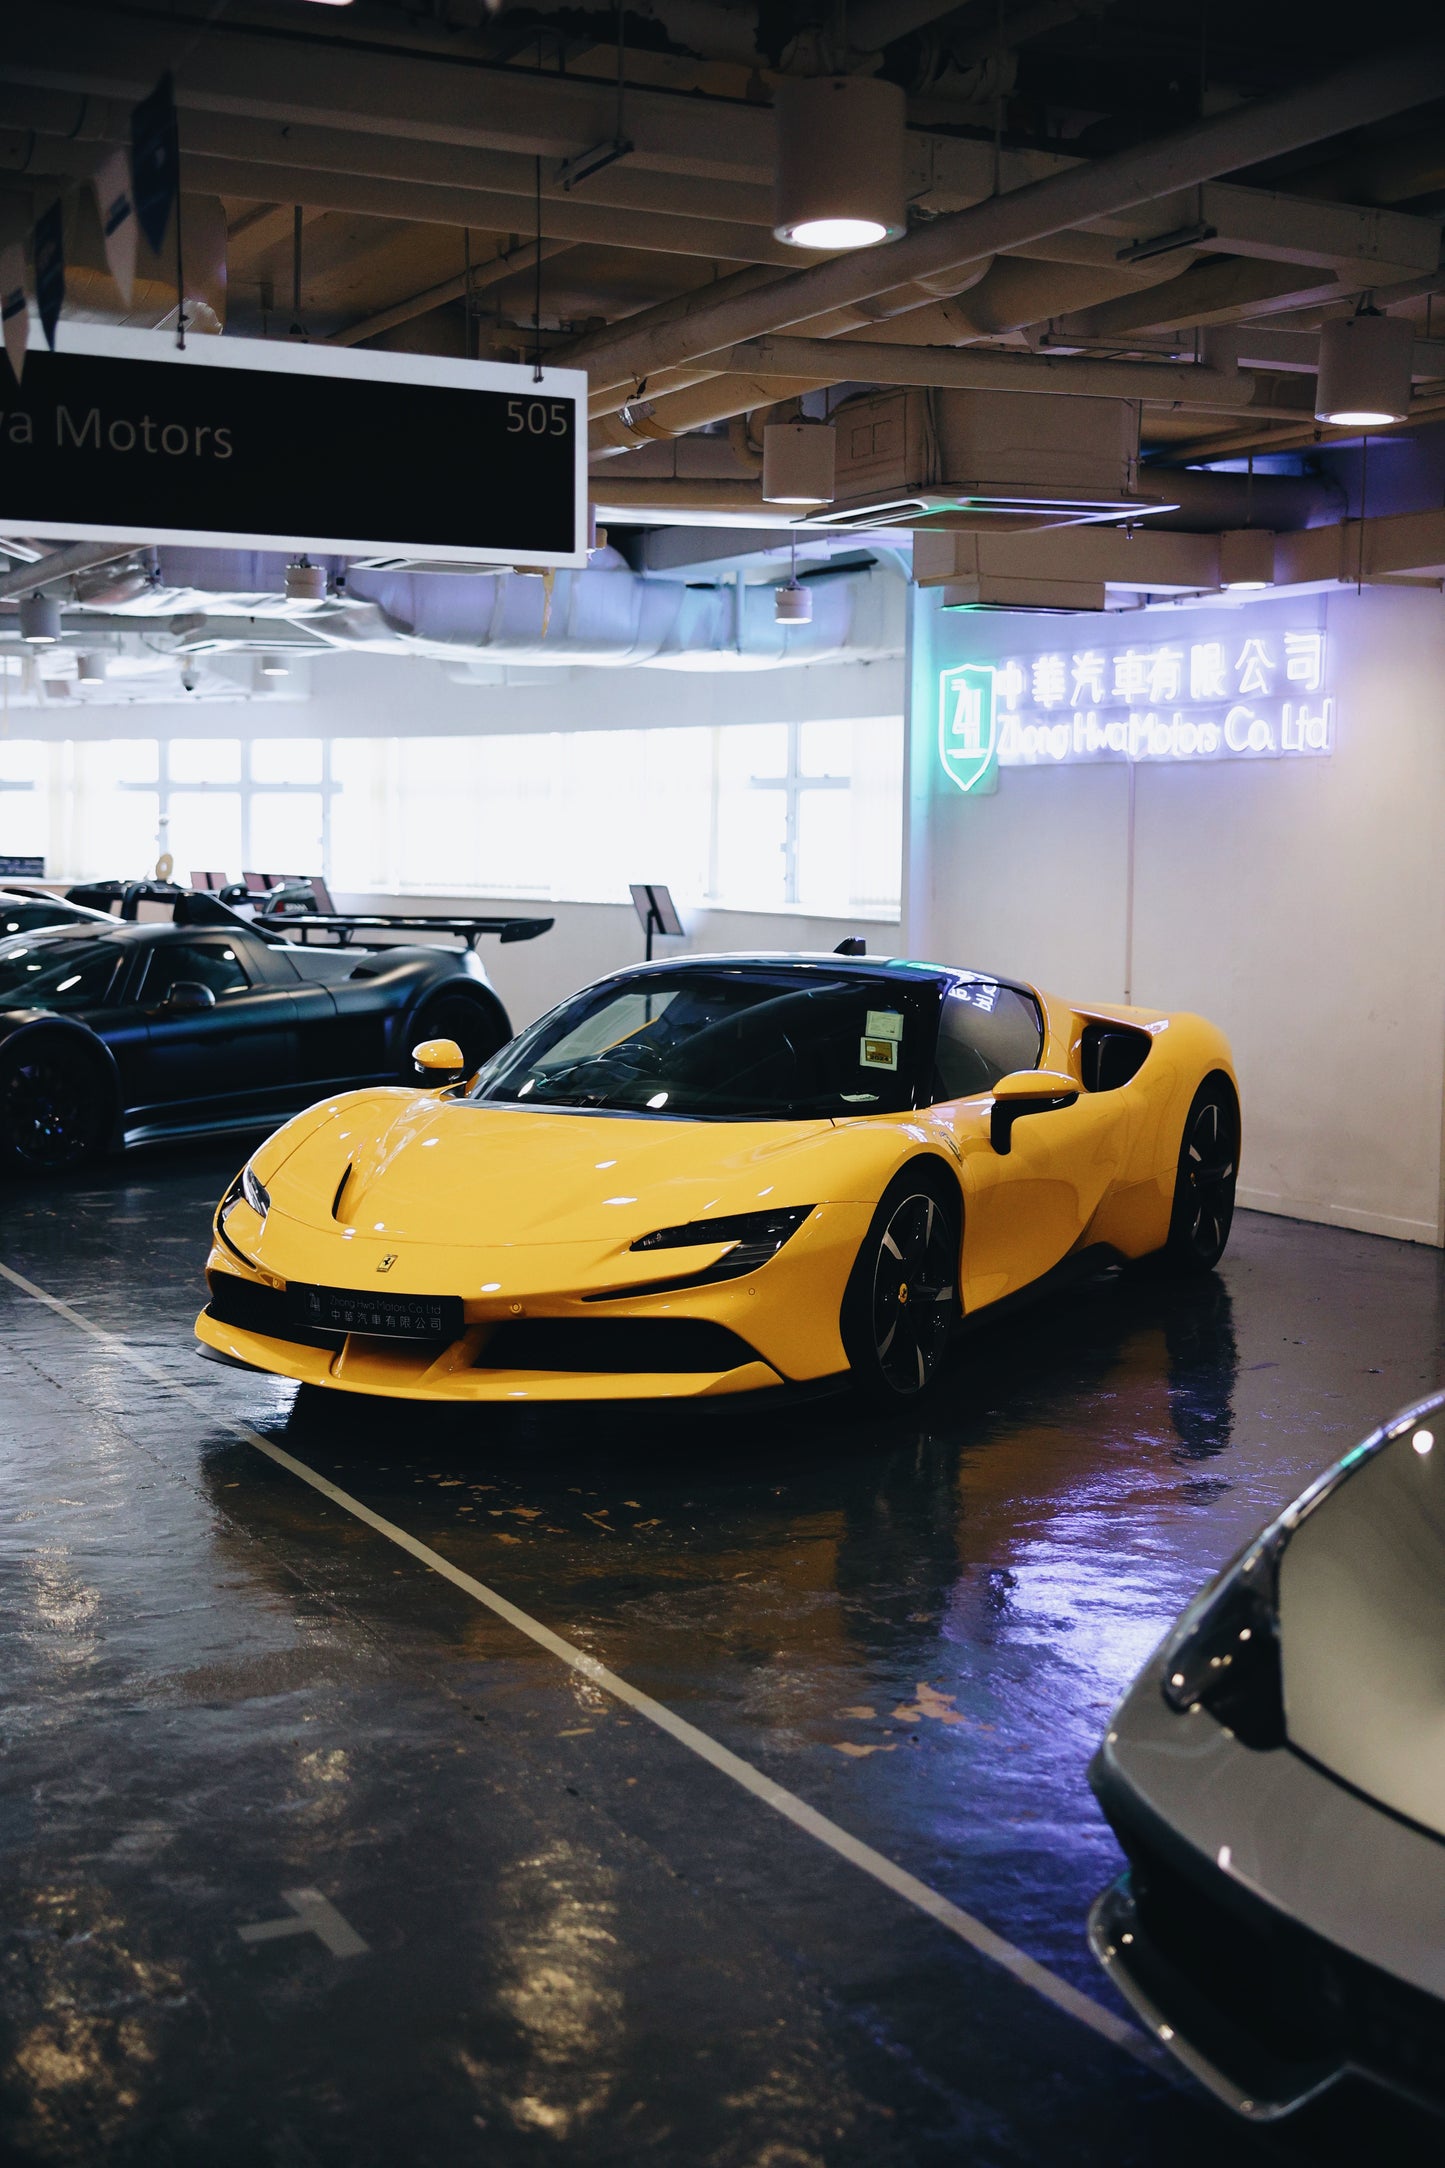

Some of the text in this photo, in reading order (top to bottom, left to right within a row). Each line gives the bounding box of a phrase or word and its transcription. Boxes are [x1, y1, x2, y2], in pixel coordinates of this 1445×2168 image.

[56, 404, 233, 459] Motors
[507, 401, 568, 436] 505
[994, 631, 1322, 711] 中華汽車有限公司
[996, 714, 1070, 760] Zhong
[1073, 711, 1128, 752] Hwa
[1129, 712, 1220, 756] Motors
[1281, 698, 1332, 751] Ltd
[870, 1054, 889, 1062] 2024
[330, 1295, 355, 1309] Zhong
[357, 1298, 375, 1310] Hwa
[376, 1299, 406, 1312] Motors
[426, 1304, 441, 1315] Ltd
[330, 1309, 441, 1331] 中華汽車有限公司
